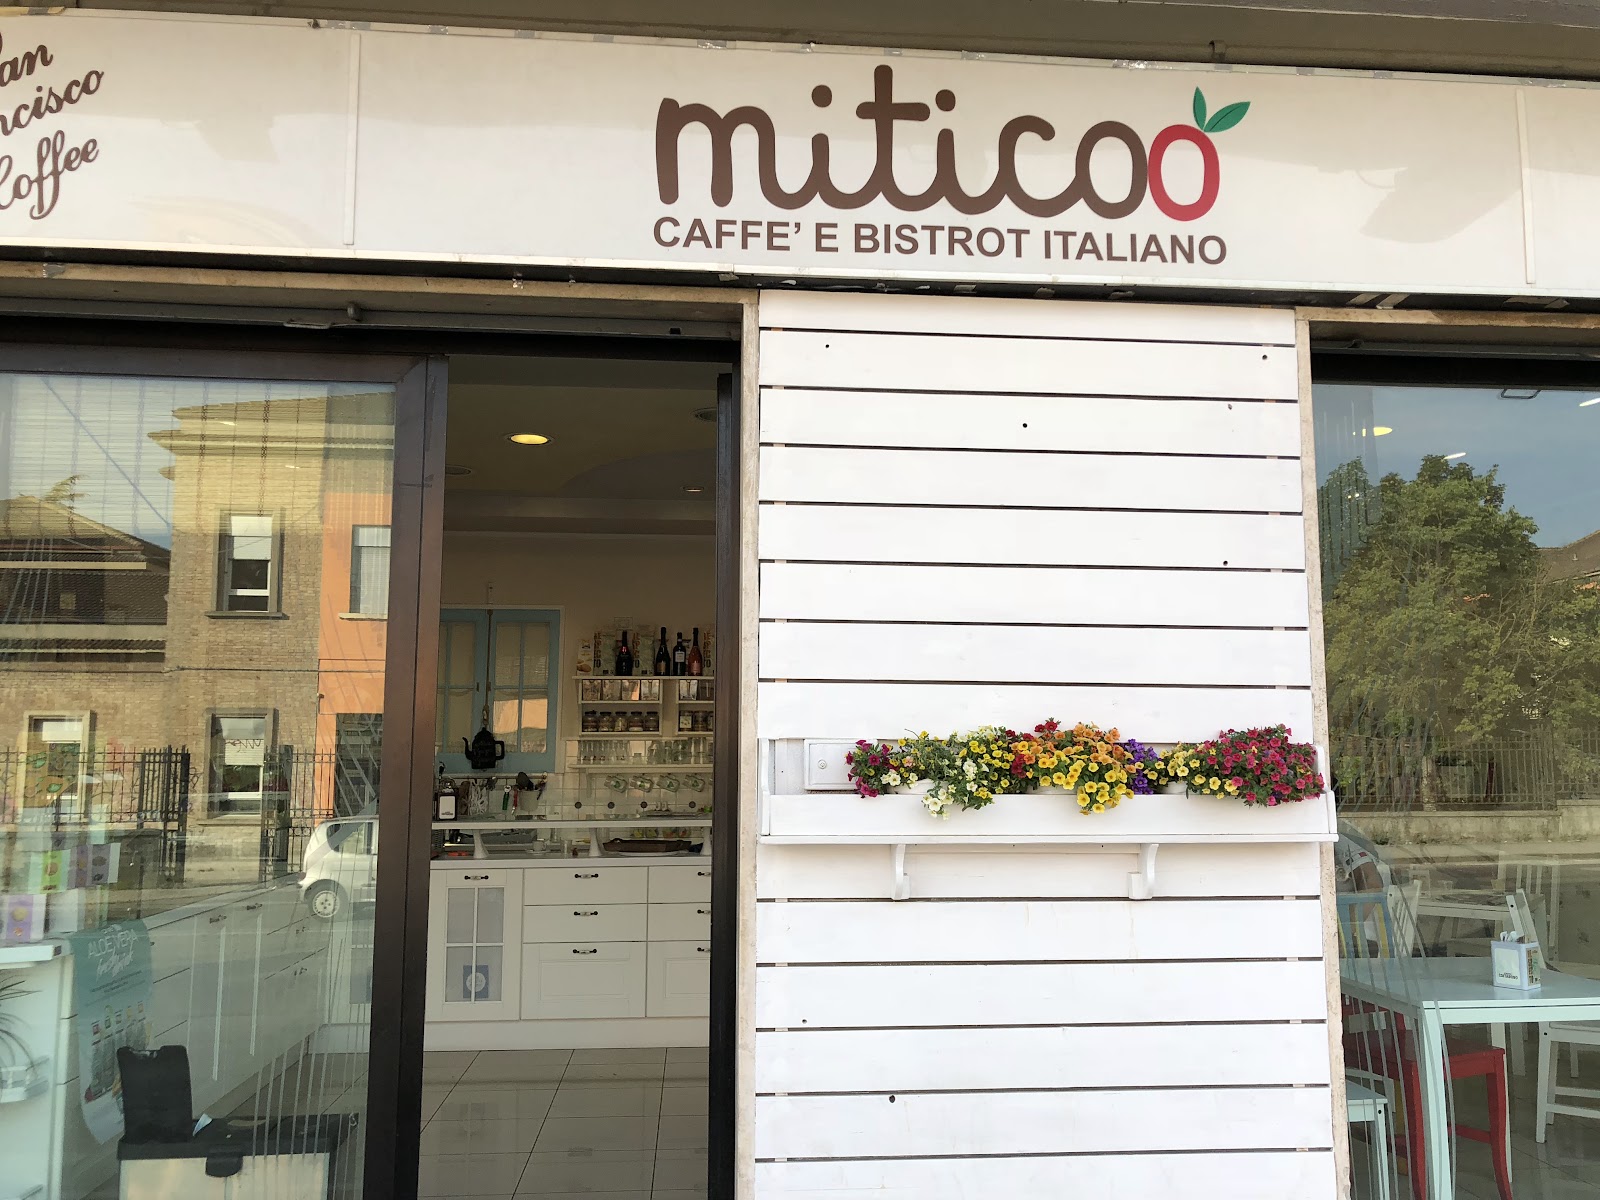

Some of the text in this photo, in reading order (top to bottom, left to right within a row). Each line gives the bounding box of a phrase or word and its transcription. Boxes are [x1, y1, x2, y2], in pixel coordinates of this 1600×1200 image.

[0, 33, 54, 88] an
[815, 222, 839, 253] E
[854, 223, 1031, 258] BISTROT
[1044, 230, 1228, 265] ITALIANO
